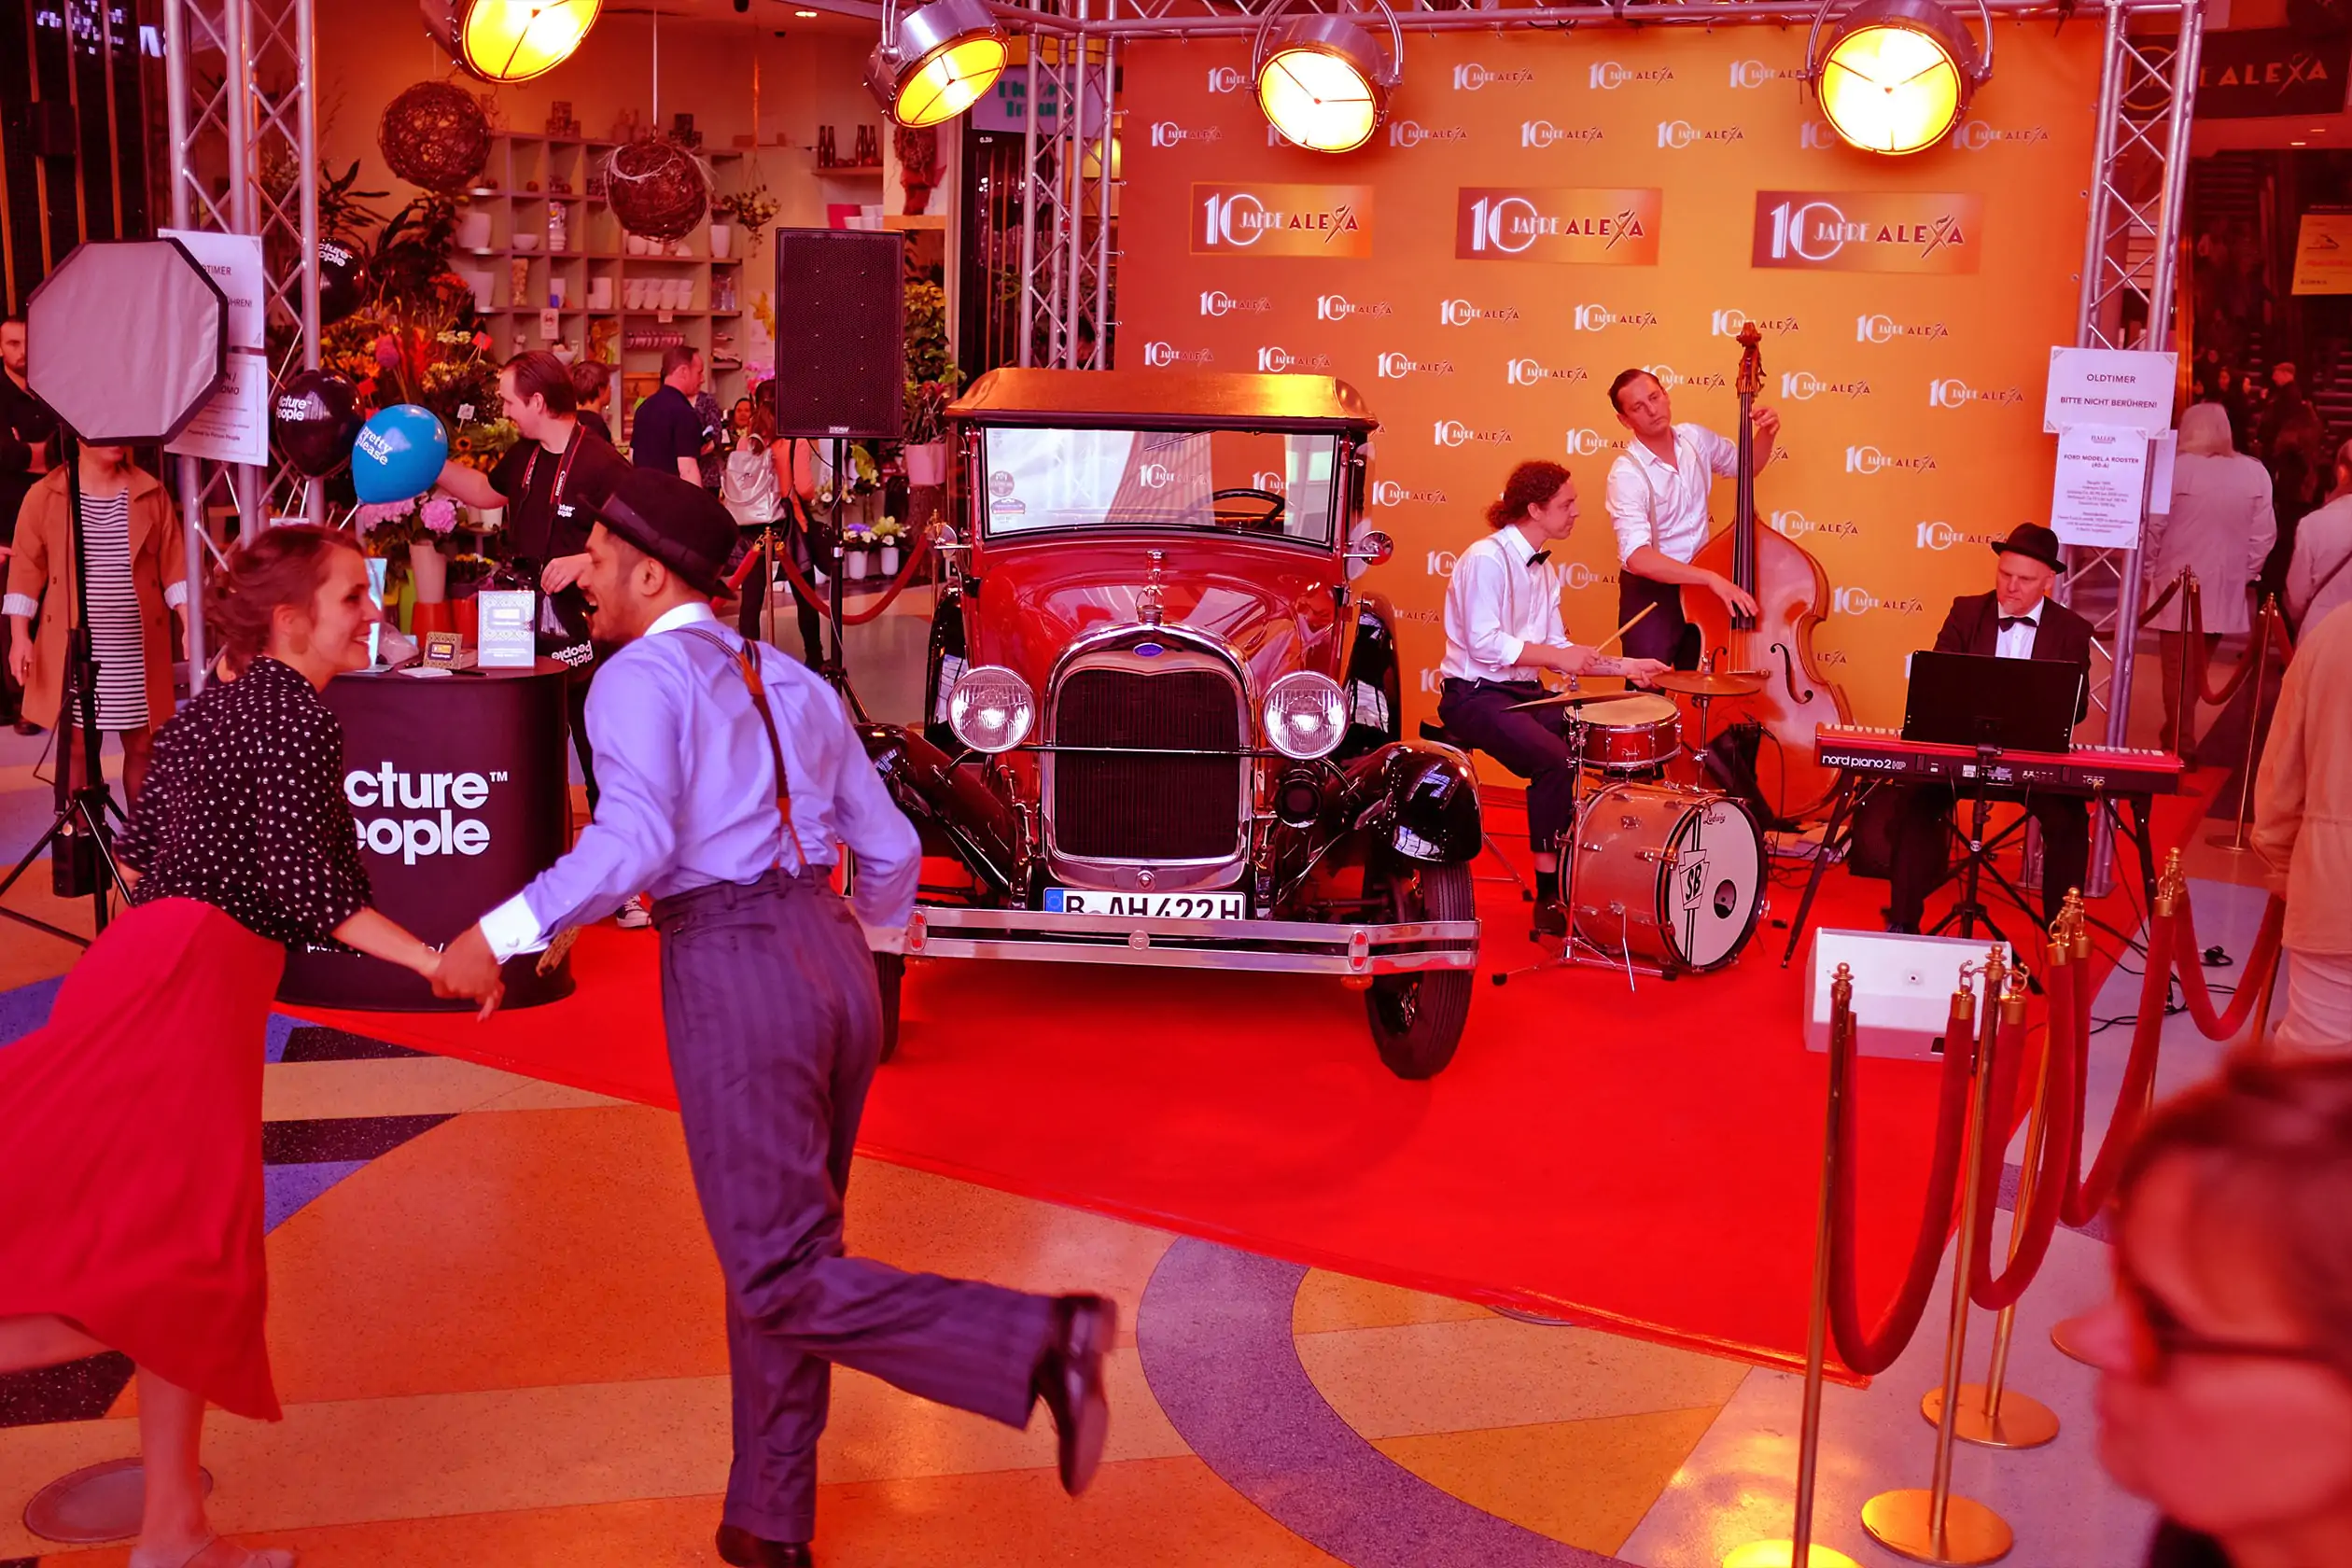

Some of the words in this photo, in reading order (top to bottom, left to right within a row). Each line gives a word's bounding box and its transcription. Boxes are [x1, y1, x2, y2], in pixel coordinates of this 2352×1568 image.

[1208, 67, 1237, 92] 10
[1453, 63, 1485, 91] 10
[1589, 62, 1622, 90] 10
[1729, 60, 1764, 89] 10
[2218, 52, 2328, 97] ALEXA
[1151, 121, 1179, 147] 10
[1390, 120, 1420, 147] 10
[1520, 120, 1554, 147] 10
[1657, 120, 1691, 148] 10
[1953, 120, 1991, 150] 10
[1204, 193, 1264, 245] 10
[1239, 211, 1283, 230] JAHRE
[1288, 204, 1359, 244] ALEXA
[1470, 197, 1538, 252] 10
[1510, 217, 1560, 235] JAHRE
[1565, 208, 1645, 250] ALEXA
[1770, 201, 1845, 260] 10
[1813, 223, 1869, 242] JAHRE
[1875, 215, 1964, 259] ALEXA
[202, 265, 231, 275] TIMER
[318, 250, 345, 267] ople
[228, 299, 252, 308] HREN!
[1199, 290, 1228, 315] 10
[1317, 295, 1347, 320] 10
[1440, 299, 1472, 326] 10
[1575, 303, 1606, 331] 10
[1711, 309, 1745, 337] 10
[1856, 314, 1893, 343] 10
[1144, 342, 1172, 367] 10
[1257, 346, 1286, 372] 10
[1378, 352, 1407, 378] 10
[1506, 358, 1539, 385] 10
[1781, 371, 1816, 399] 10
[2086, 373, 2136, 384] OLDTIMER
[1929, 378, 1967, 408] 10
[2060, 396, 2082, 404] BITTE
[2084, 398, 2109, 406] NICHT
[2111, 399, 2157, 408] BERÜHREN!
[357, 426, 393, 455] pretty
[1434, 420, 1465, 447] 10
[1566, 428, 1599, 455] 10
[356, 437, 388, 466] please
[1845, 445, 1882, 474] 10
[1140, 464, 1168, 488] 10
[1372, 480, 1401, 507] 10
[1771, 511, 1805, 539] 10
[1916, 521, 1953, 551] 10
[1833, 585, 1869, 615] 10
[552, 639, 591, 662] people
[565, 651, 594, 667] pictu
[1816, 651, 1847, 668] LEXA
[1822, 755, 1850, 764] nord
[1851, 757, 1883, 768] piano
[1883, 759, 1892, 769] 2
[343, 761, 489, 809] cture
[1702, 813, 1726, 825] Ludwig
[354, 808, 491, 865] ople
[1686, 862, 1702, 901] SB
[1066, 895, 1085, 914] B
[1110, 896, 1148, 917] AH
